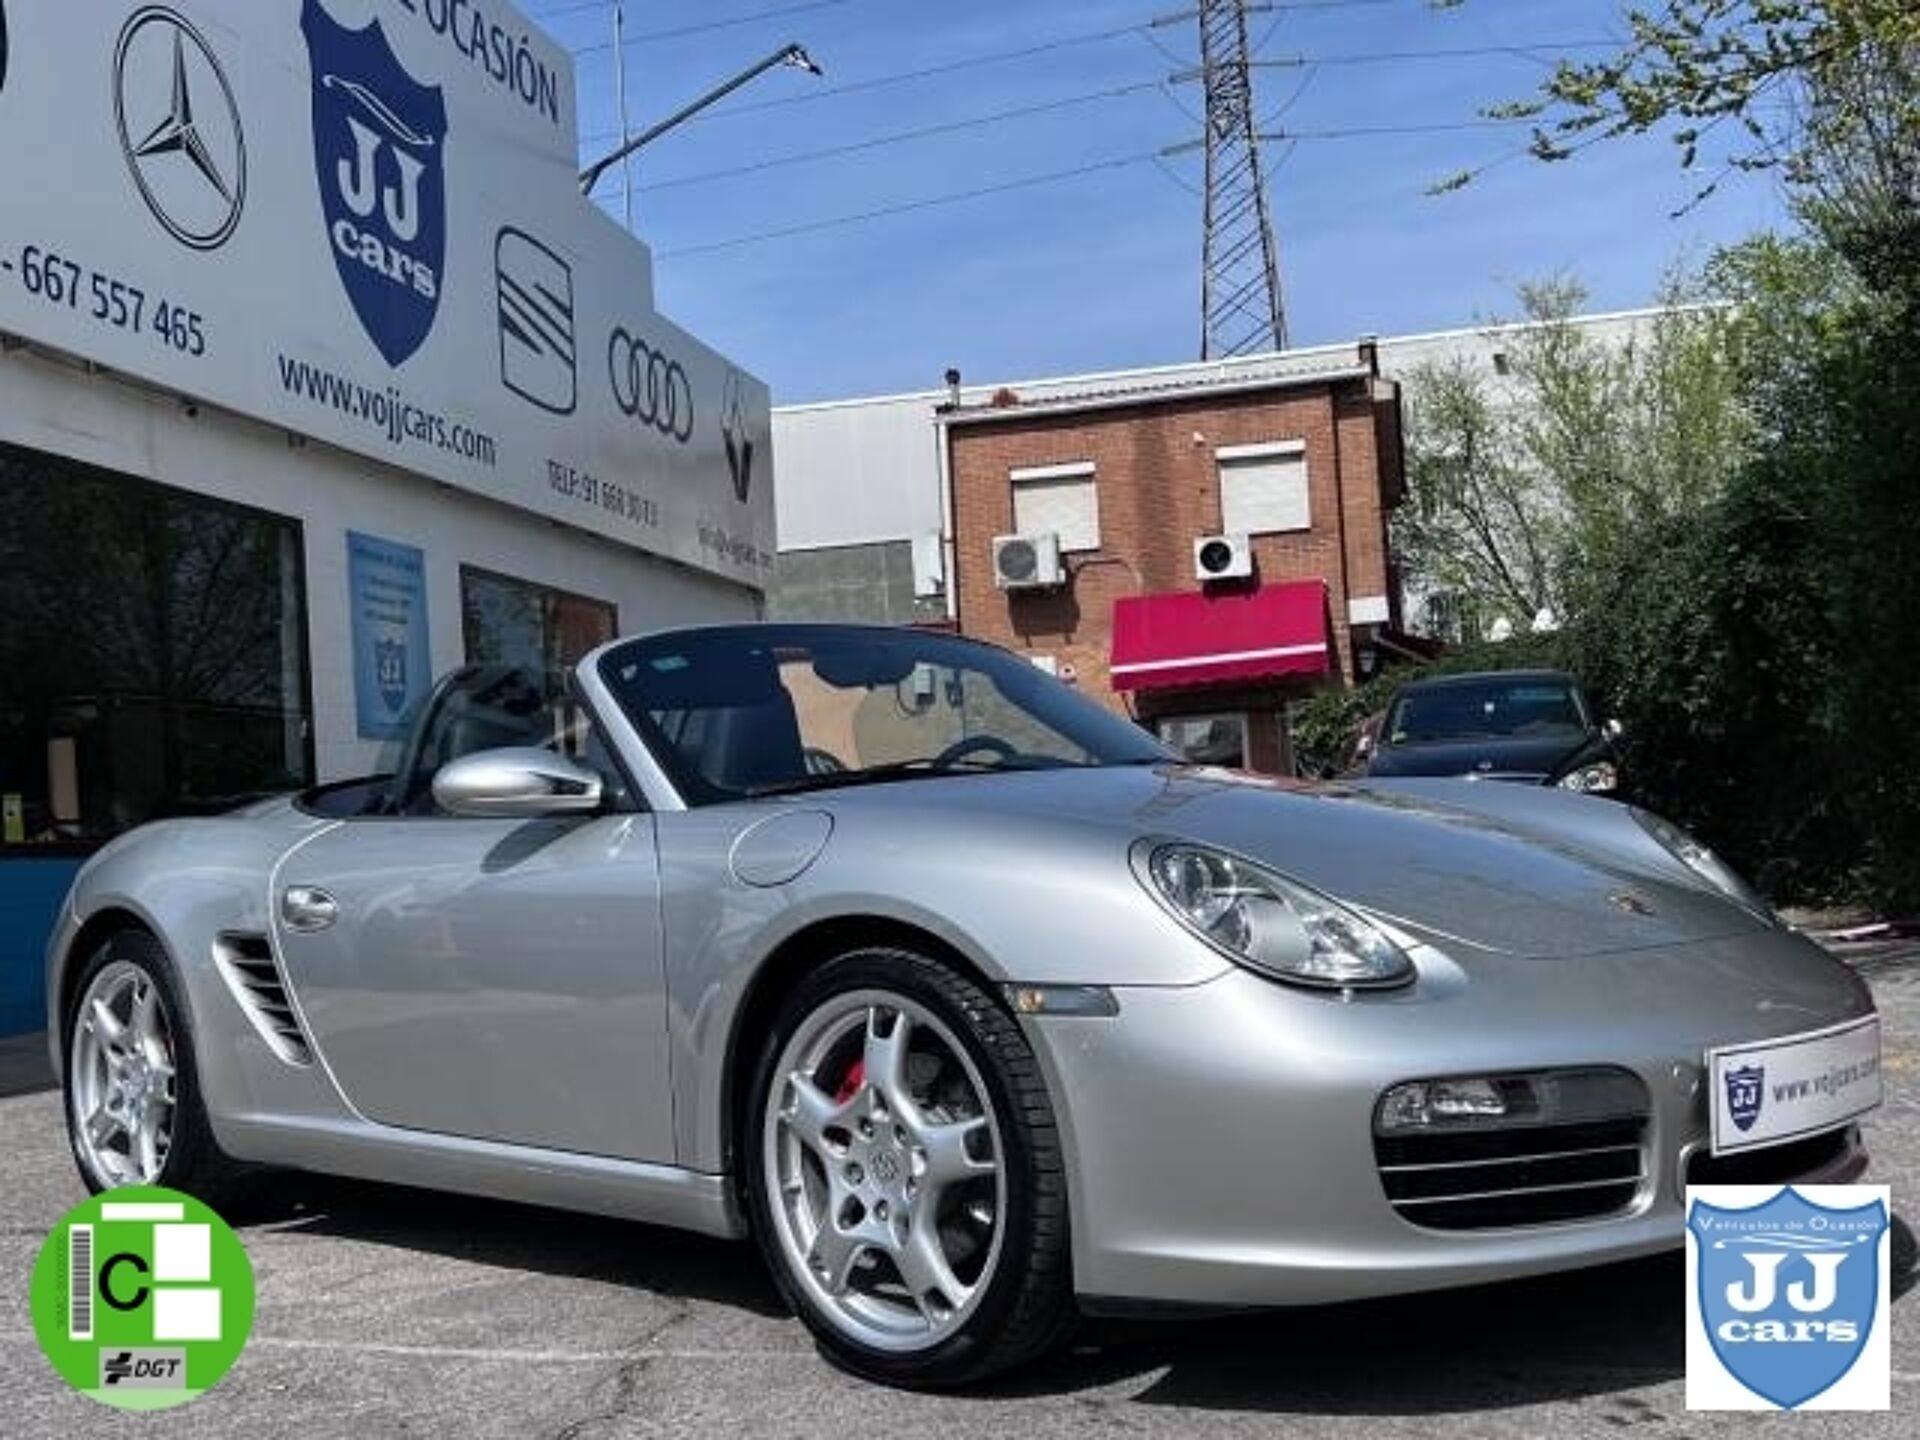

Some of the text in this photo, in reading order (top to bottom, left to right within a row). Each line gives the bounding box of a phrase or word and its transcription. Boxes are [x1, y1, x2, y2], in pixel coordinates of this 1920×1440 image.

[338, 116, 427, 242] JJ
[22, 245, 81, 308] 667
[92, 272, 144, 333] 557
[153, 299, 205, 356] 465
[333, 219, 436, 298] cars
[278, 352, 496, 466] www.vojjcars.com
